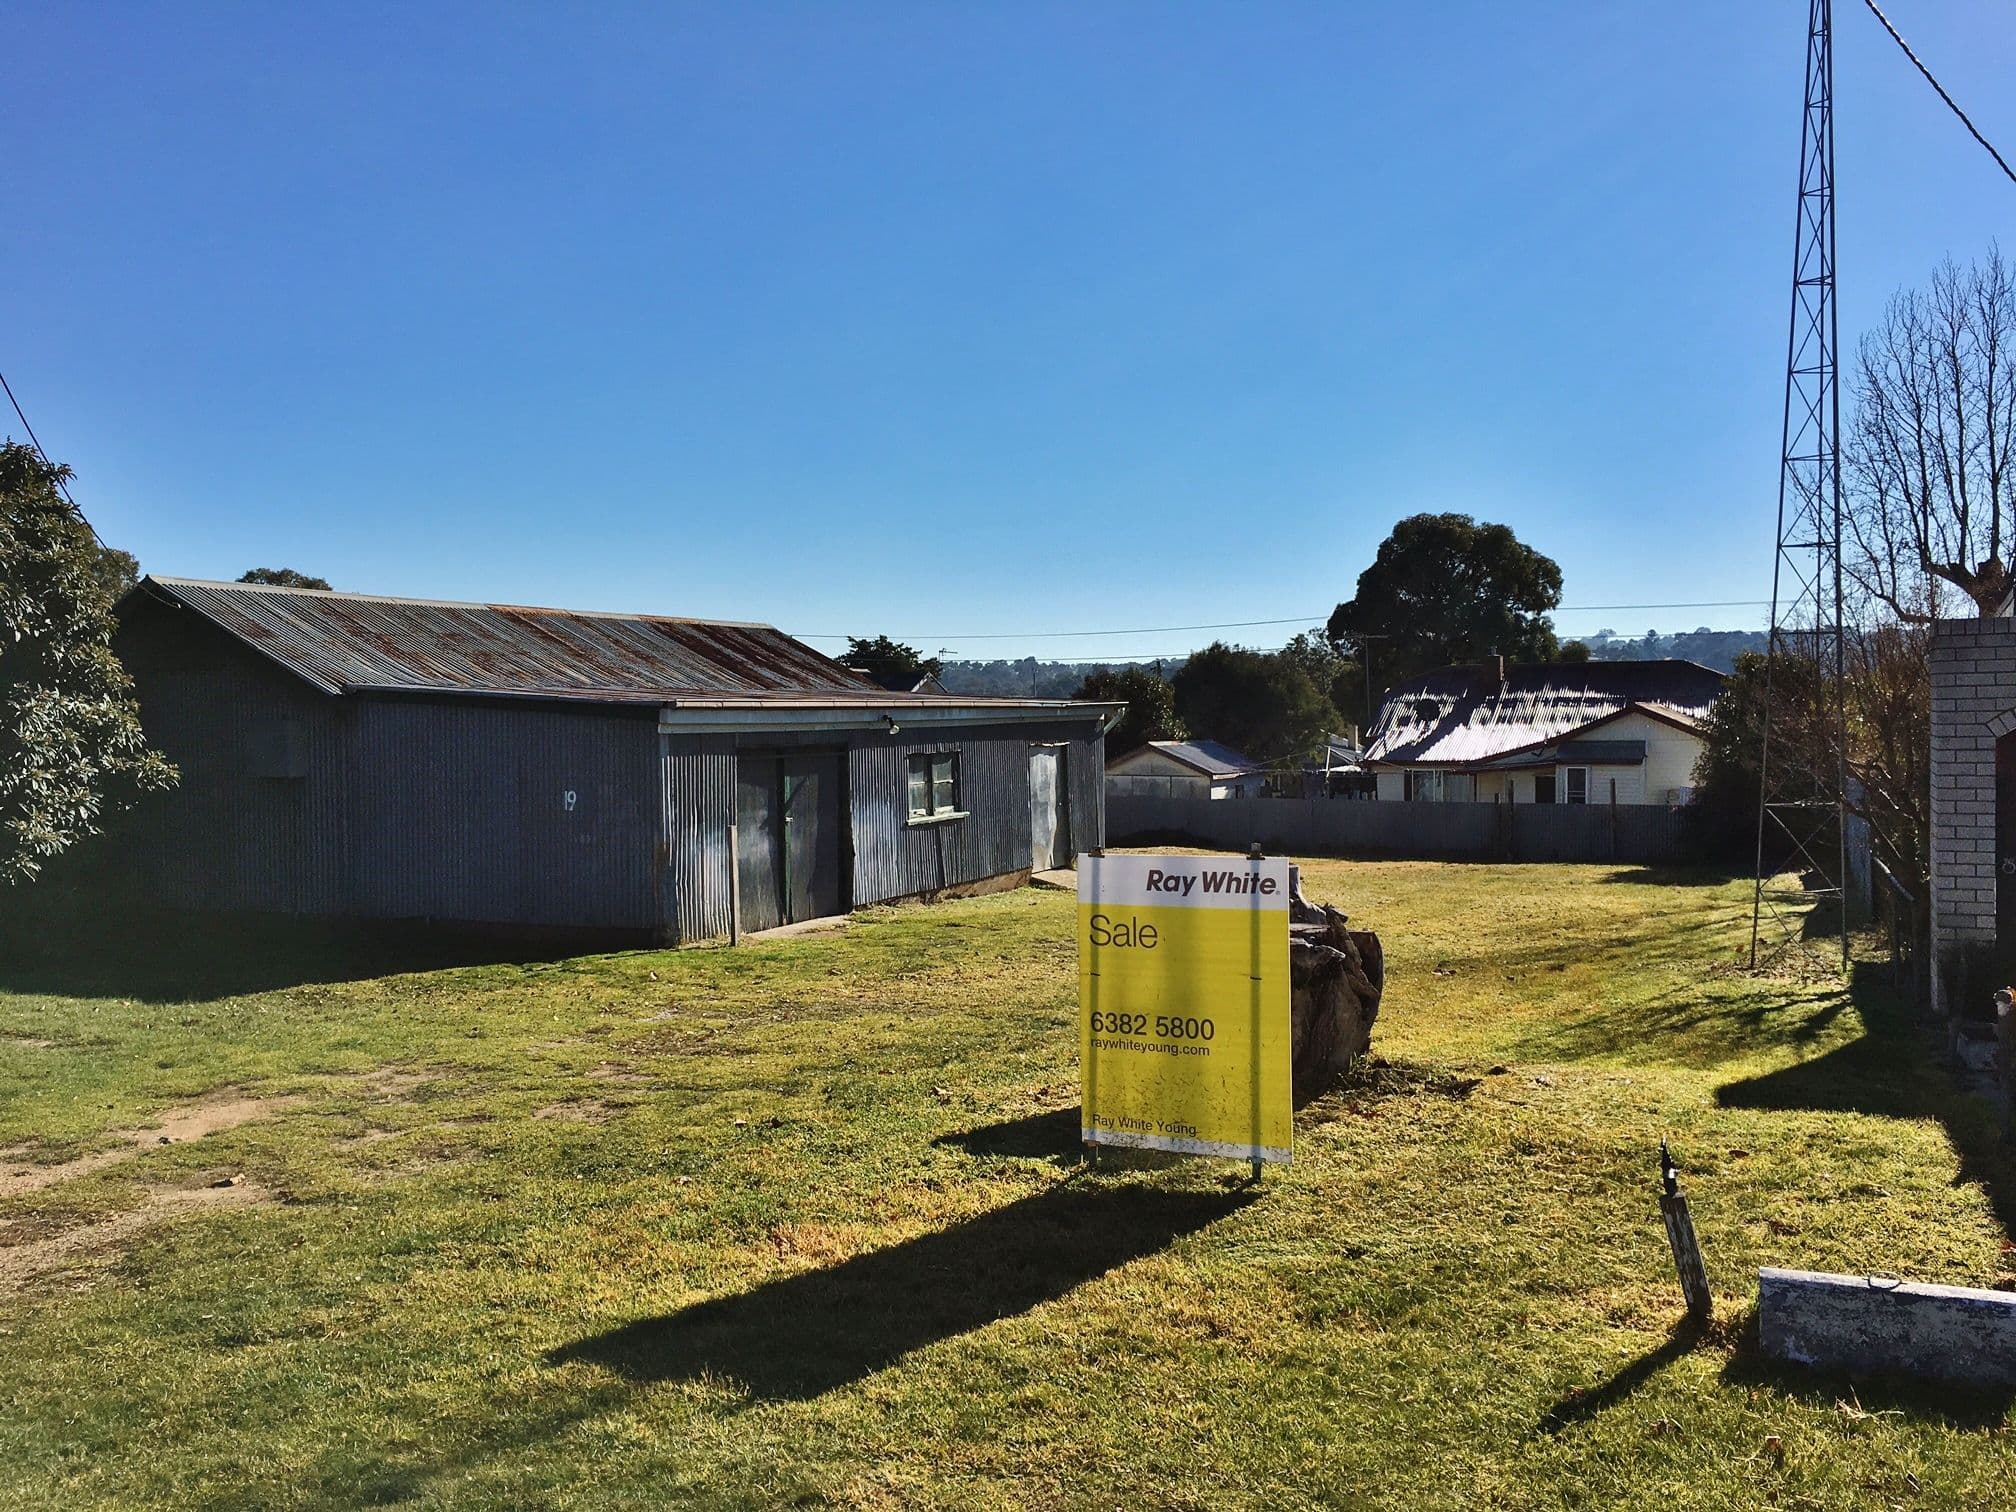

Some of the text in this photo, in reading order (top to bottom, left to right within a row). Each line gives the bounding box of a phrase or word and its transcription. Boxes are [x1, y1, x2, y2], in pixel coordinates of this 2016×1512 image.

[564, 790, 577, 811] 19
[1146, 869, 1278, 897] Ray White
[1089, 914, 1158, 949] Sale
[1090, 1011, 1215, 1041] 6382 5800
[1090, 1037, 1210, 1057] raywhiteyoung.com
[1092, 1114, 1197, 1137] Ray White Young
